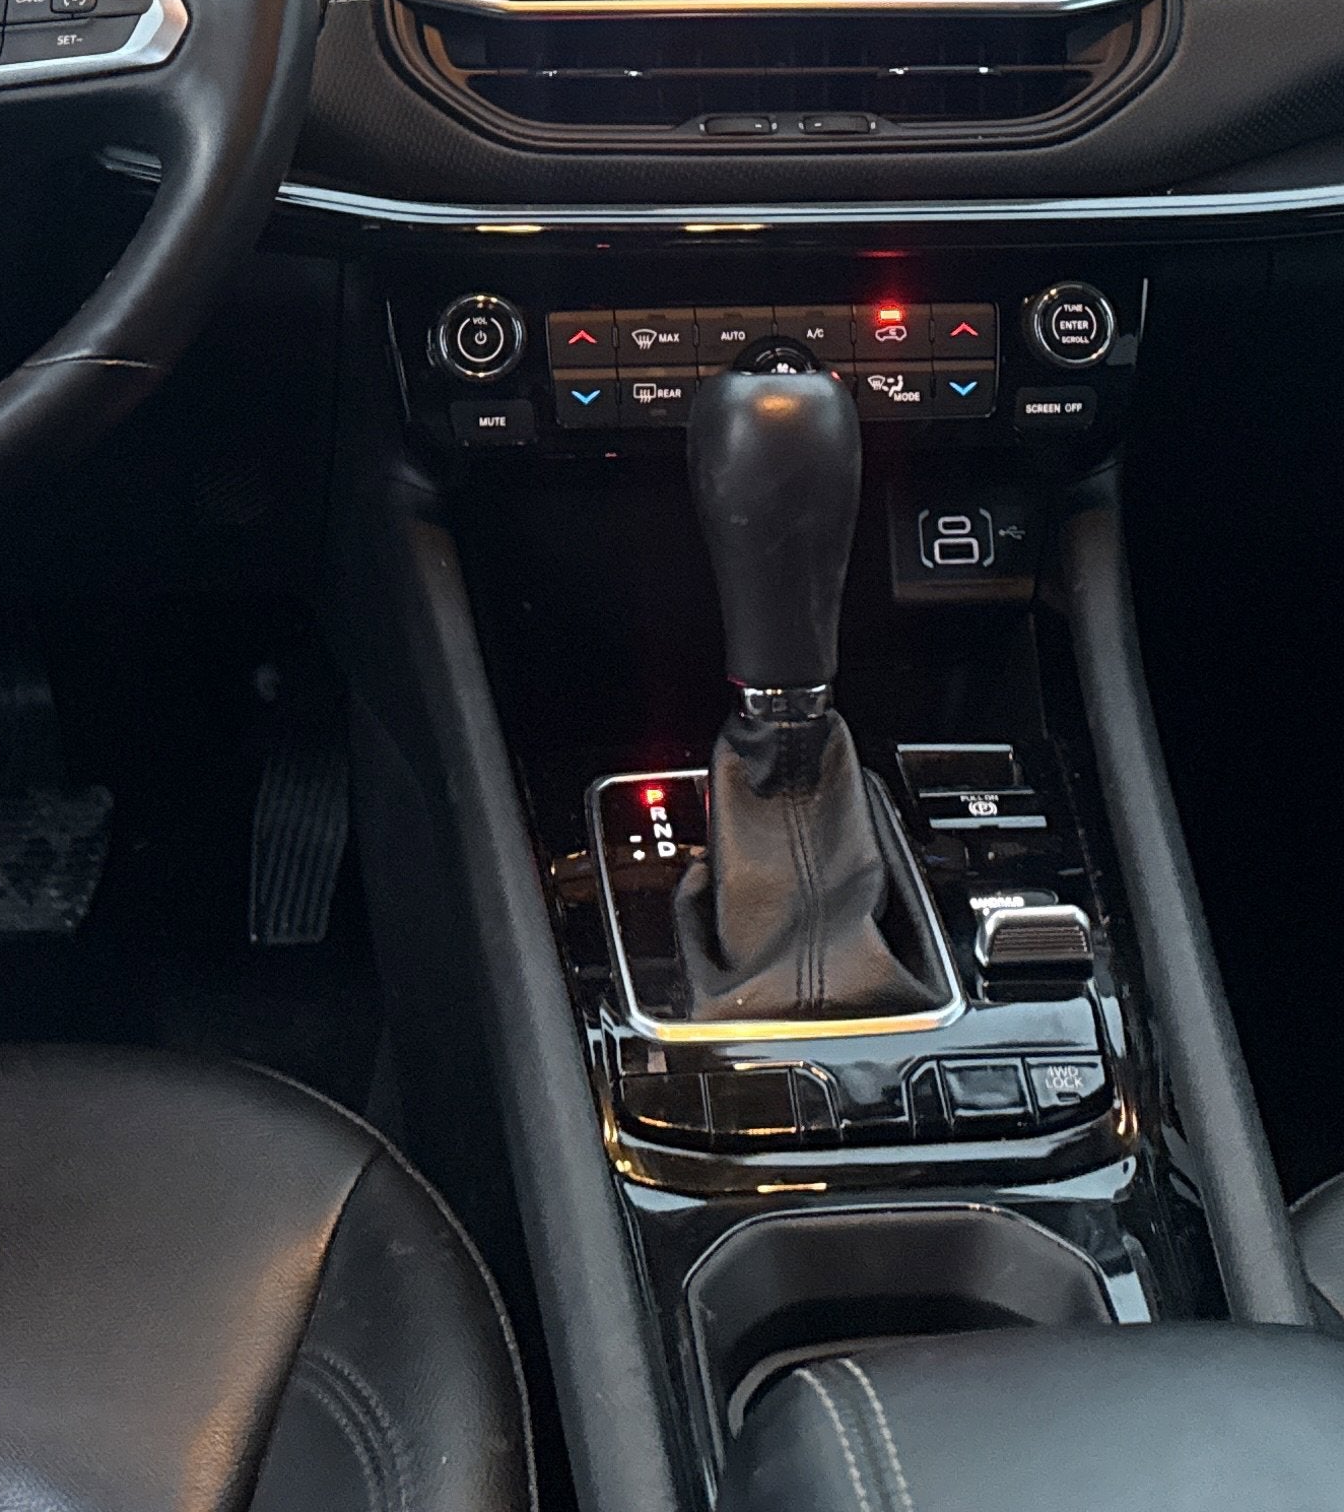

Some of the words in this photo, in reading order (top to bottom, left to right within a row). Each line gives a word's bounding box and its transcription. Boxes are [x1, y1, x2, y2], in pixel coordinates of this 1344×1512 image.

[1063, 304, 1083, 313] TUNE
[472, 317, 488, 325] VOL
[1059, 320, 1089, 331] ENTER
[658, 333, 680, 343] MAX
[721, 331, 746, 341] AUTO
[806, 327, 824, 339] A/C
[1061, 335, 1090, 344] SCROLL
[657, 388, 682, 399] REAR
[893, 391, 920, 402] MODE
[1025, 403, 1061, 414] SCREEN
[1065, 402, 1083, 413] OFF
[479, 416, 506, 427] MUTE
[646, 789, 664, 804] P
[650, 806, 668, 821] R
[653, 822, 673, 839] N
[657, 841, 676, 858] D
[1045, 1076, 1084, 1089] LOCK
